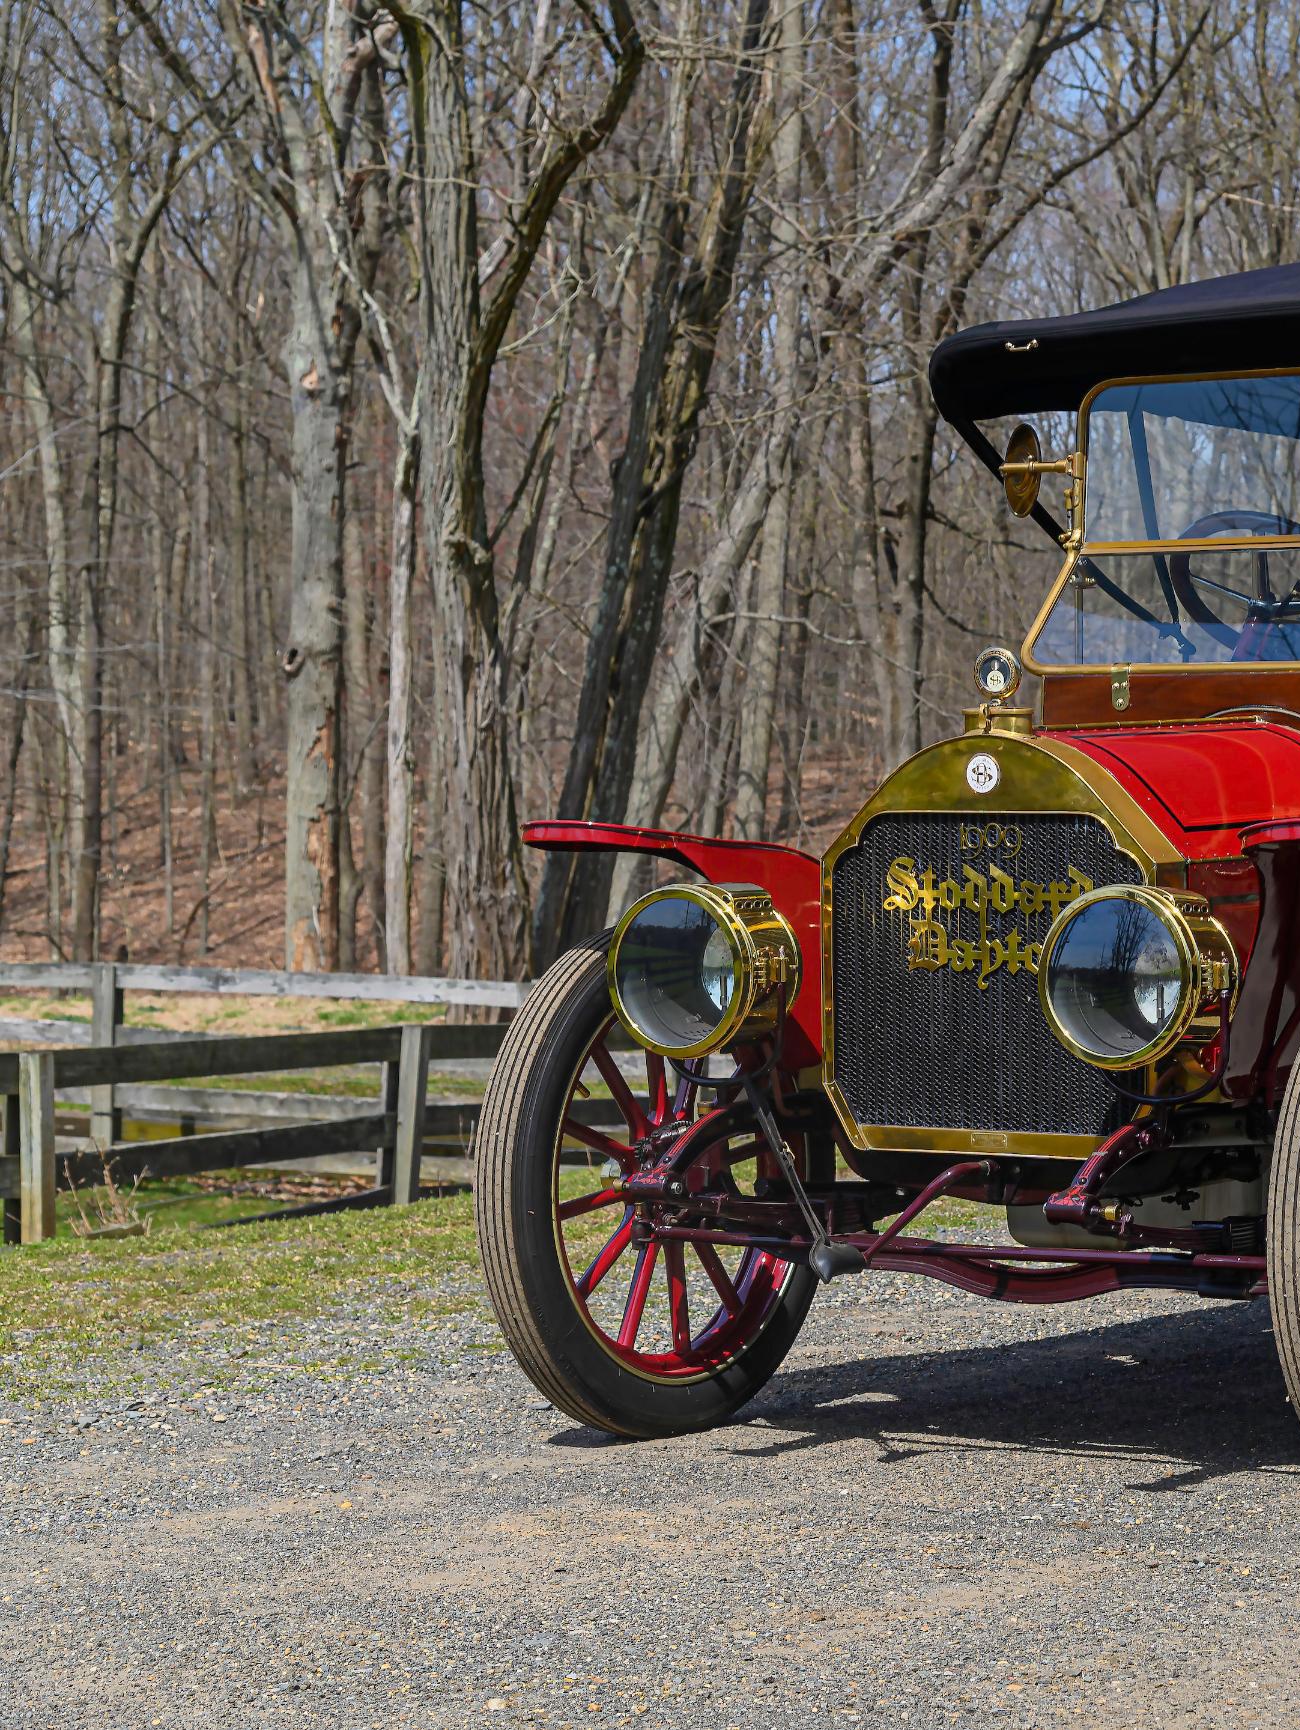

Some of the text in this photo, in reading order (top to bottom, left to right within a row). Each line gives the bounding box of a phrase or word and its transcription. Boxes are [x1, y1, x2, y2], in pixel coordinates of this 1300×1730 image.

[960, 822, 1023, 859] 1909
[883, 857, 1094, 921] Stoddard
[908, 919, 1043, 990] Dayto
